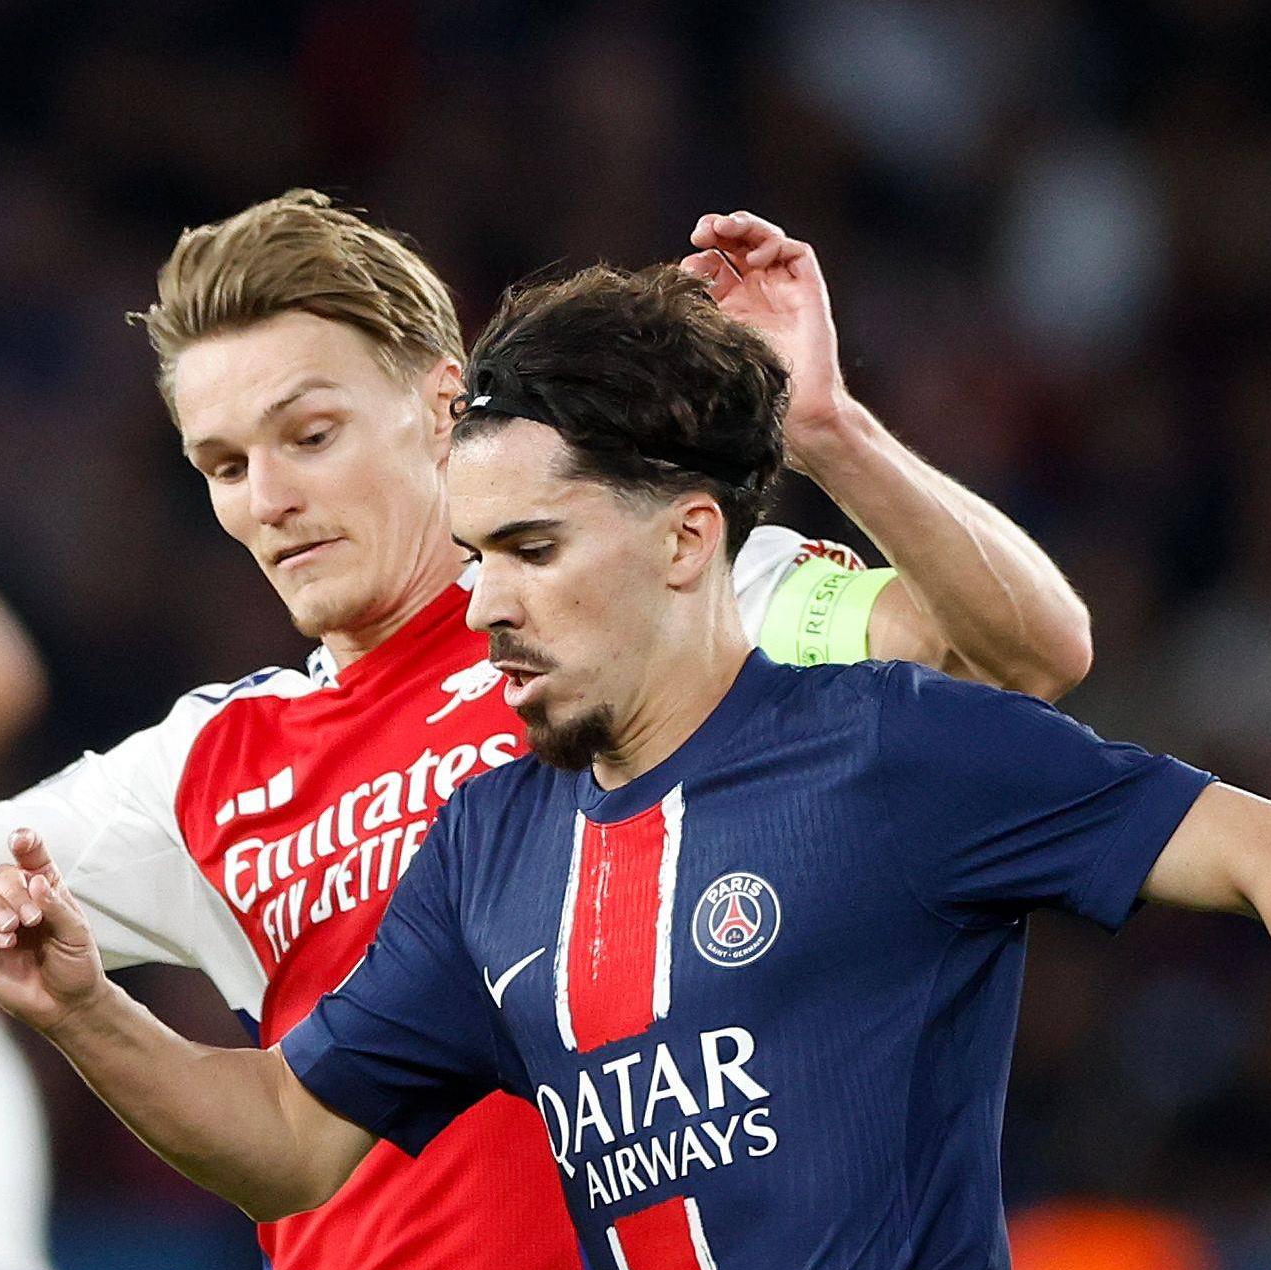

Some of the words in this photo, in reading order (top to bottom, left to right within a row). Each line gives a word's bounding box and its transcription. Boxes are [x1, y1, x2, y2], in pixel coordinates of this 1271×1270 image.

[224, 733, 518, 914] Emirates
[309, 817, 439, 924] ETTE
[706, 877, 763, 905] PARIS
[536, 1026, 771, 1179] QATAR
[586, 1107, 778, 1210] AIRWAYS
